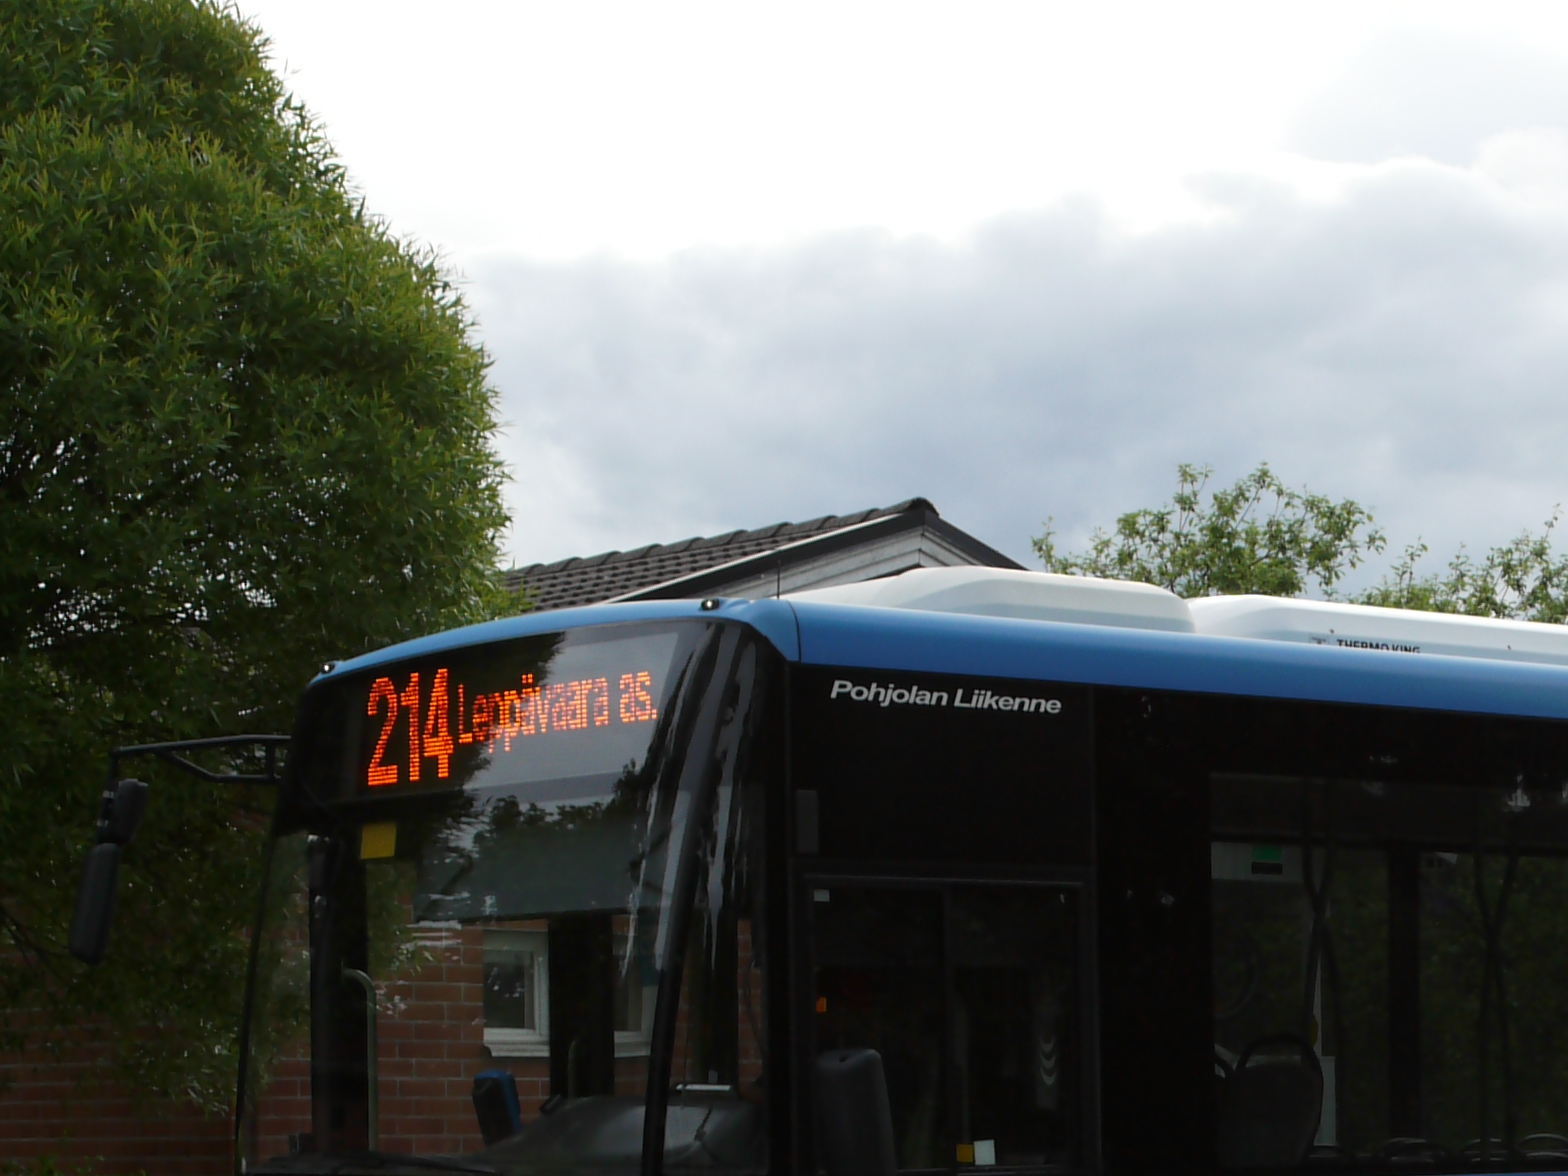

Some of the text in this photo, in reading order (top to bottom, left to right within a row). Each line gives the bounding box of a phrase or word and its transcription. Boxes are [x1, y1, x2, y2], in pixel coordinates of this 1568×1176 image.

[367, 667, 658, 786] 214 Leppävaara as.
[830, 679, 1062, 714] Pohjolan Liikenne
